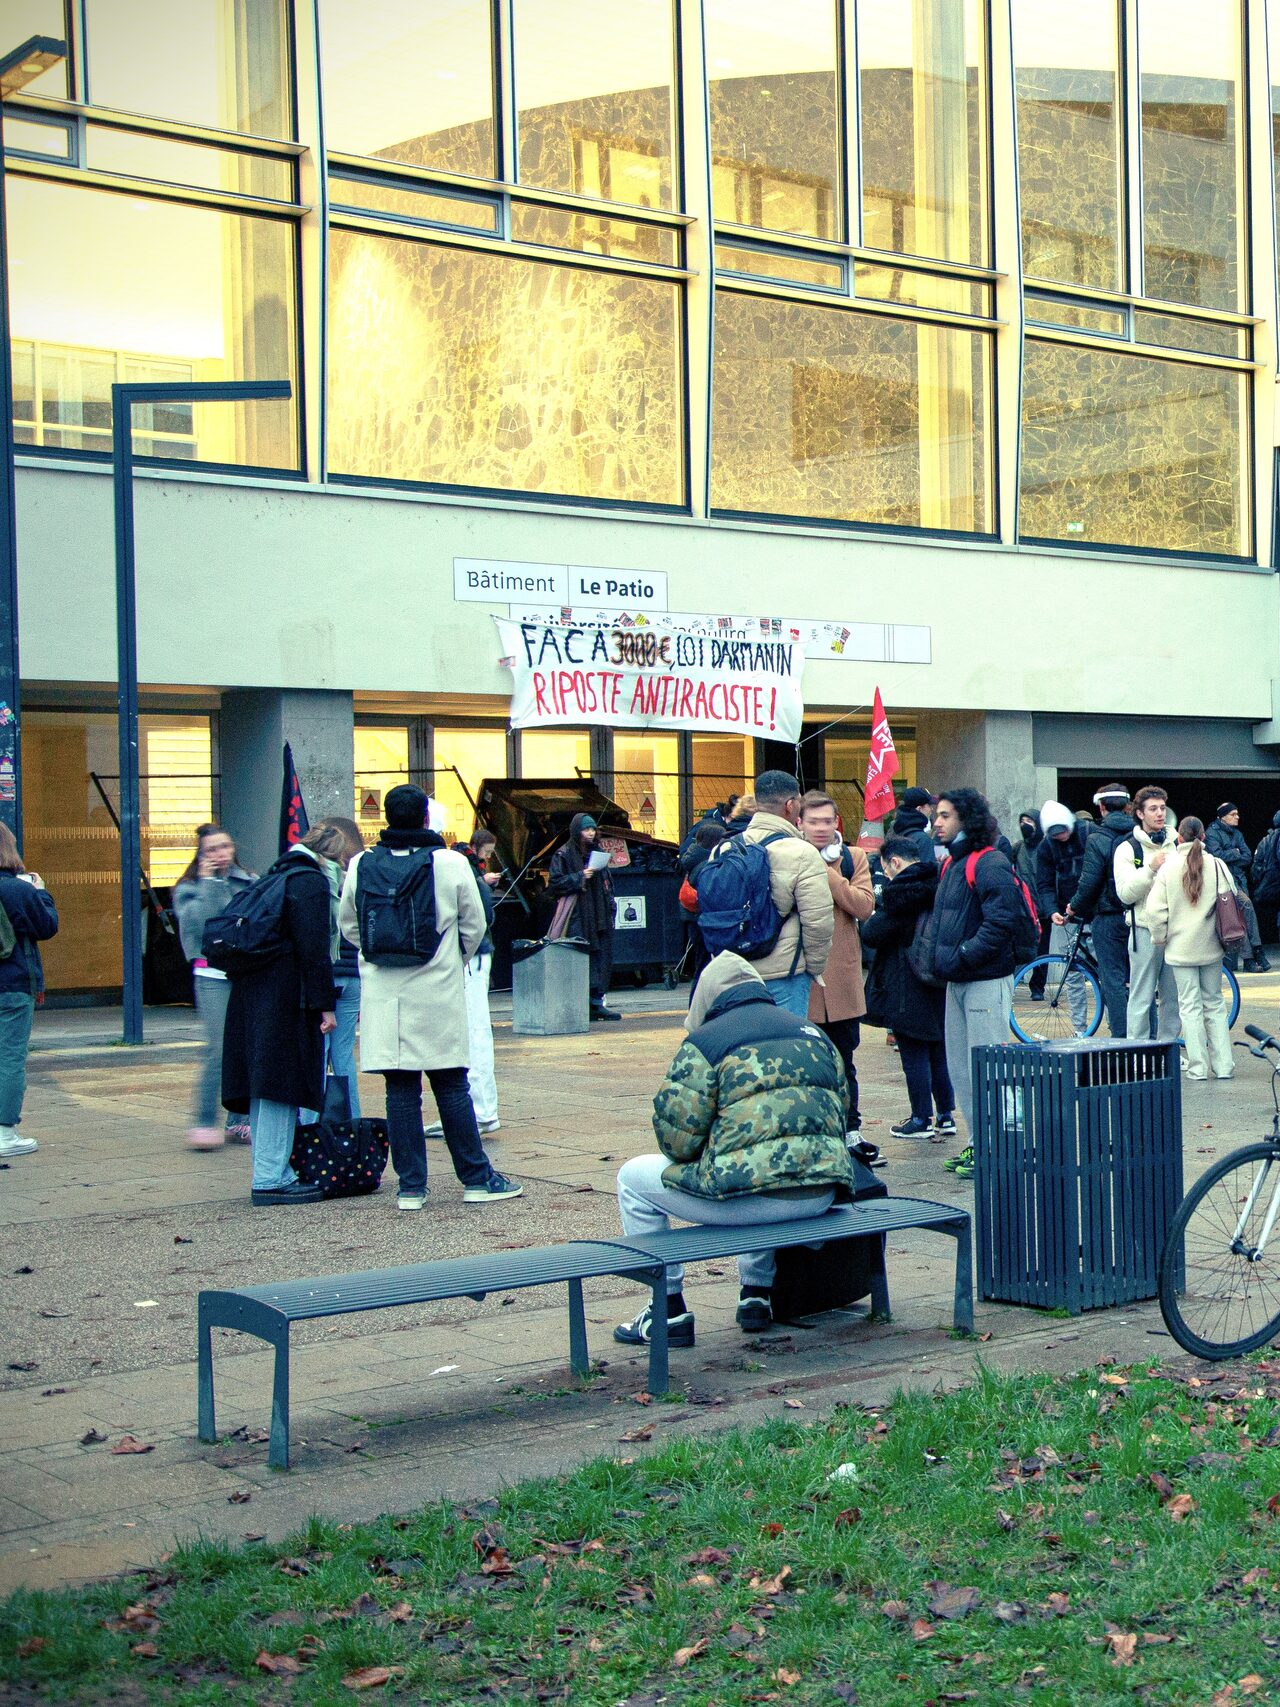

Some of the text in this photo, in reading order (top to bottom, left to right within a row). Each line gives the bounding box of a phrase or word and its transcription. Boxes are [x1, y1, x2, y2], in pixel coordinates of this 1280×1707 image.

[466, 570, 555, 592] Bâtiment
[580, 578, 654, 598] Le Patio
[520, 624, 584, 668] FAC
[677, 634, 704, 667] LOI
[711, 640, 793, 676] DARMANIN
[533, 670, 624, 716] RIPOSTE
